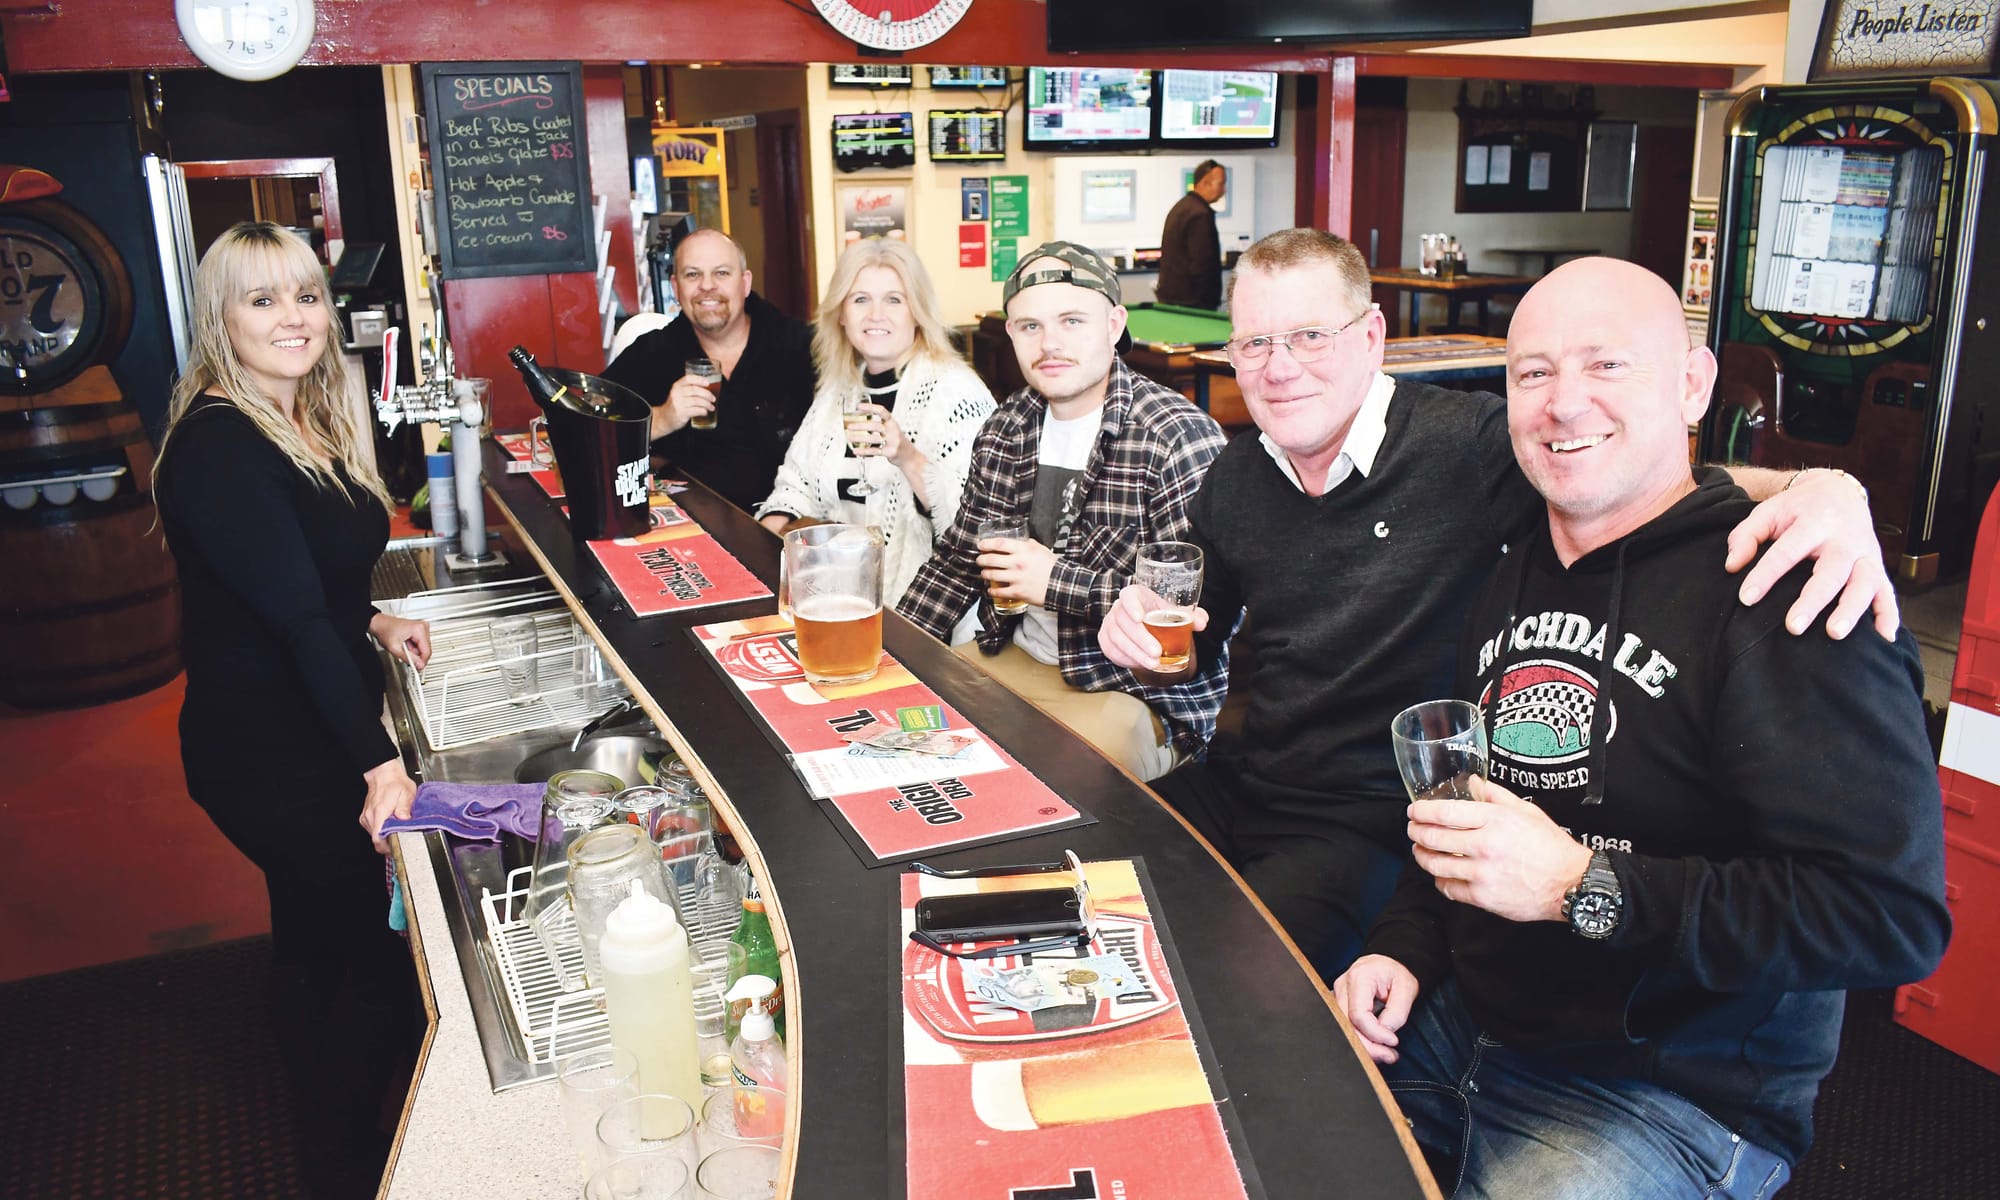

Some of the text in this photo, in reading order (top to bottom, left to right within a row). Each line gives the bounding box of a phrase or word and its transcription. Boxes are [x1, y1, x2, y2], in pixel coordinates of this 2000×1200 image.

[280, 7, 288, 16] 3
[277, 25, 285, 34] 4
[1849, 4, 1980, 43] People Listen
[226, 40, 234, 50] 7
[247, 45, 255, 54] 6
[264, 41, 273, 49] 5
[454, 75, 552, 101] SPECIALS
[446, 117, 483, 136] Beef
[488, 116, 529, 134] Ribs
[469, 139, 484, 149] a
[535, 131, 569, 144] Jack
[449, 176, 478, 192] Hot
[485, 173, 527, 192] Apple
[529, 188, 575, 205] Crumble
[452, 213, 508, 229] Served
[2, 251, 32, 268] LD
[26, 273, 66, 333] 7
[637, 547, 682, 574] LOCAL
[748, 641, 798, 674] WEST
[1477, 611, 1678, 699] RCHDALE
[1489, 759, 1589, 790] LT FOR SPEED
[937, 777, 976, 800] DRA
[889, 799, 909, 812] THE
[898, 782, 964, 826] ORIGI
[1581, 833, 1632, 853] 1968
[747, 891, 761, 900] HA
